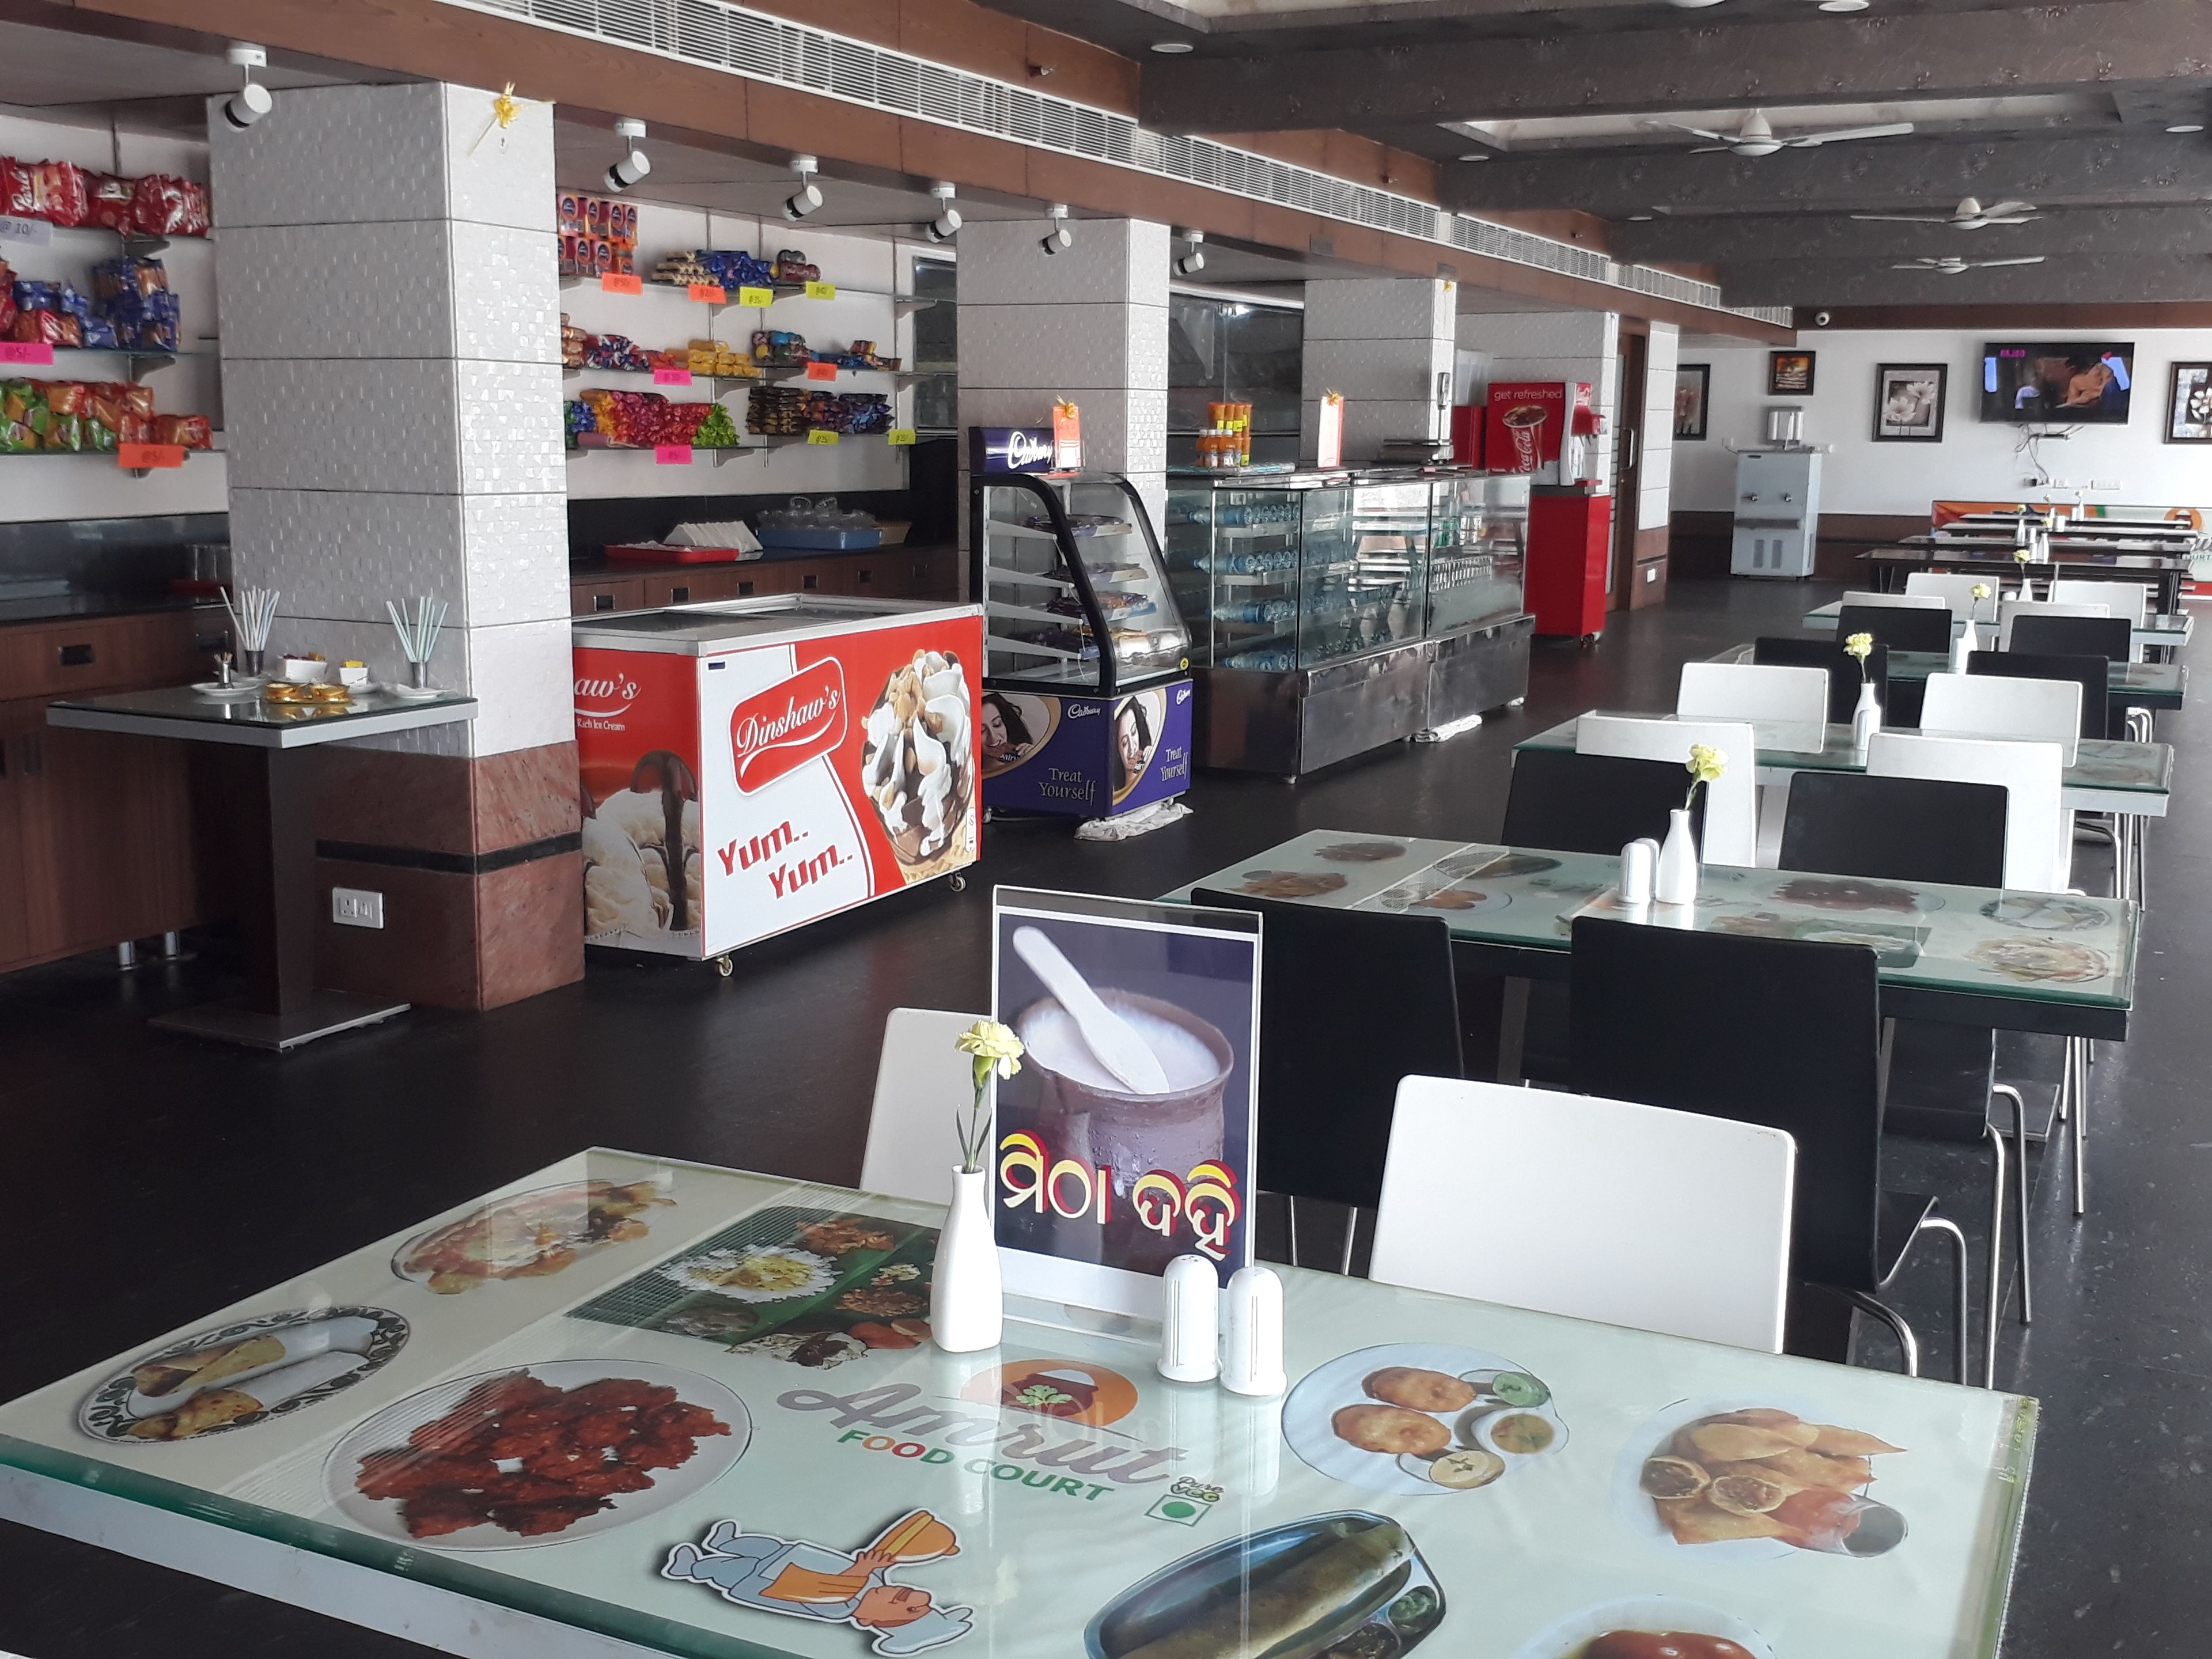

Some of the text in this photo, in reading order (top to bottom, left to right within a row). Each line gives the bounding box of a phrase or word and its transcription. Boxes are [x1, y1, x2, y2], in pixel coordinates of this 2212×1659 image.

[1494, 391, 1510, 402] get
[1513, 389, 1563, 400] refreshed
[736, 685, 841, 758] Dinshaw's
[1067, 703, 1101, 719] Cadbury
[603, 720, 626, 731] Cream
[1165, 746, 1182, 763] Treat
[1048, 768, 1083, 783] Treat
[1160, 751, 1188, 782] Yourself
[1039, 779, 1096, 806] Yourself
[999, 1130, 1242, 1262] ମିଠା ଦହି
[776, 1383, 1190, 1484] Amrut
[836, 1429, 1115, 1502] FOOD COURT
[1176, 1476, 1225, 1493] Pure
